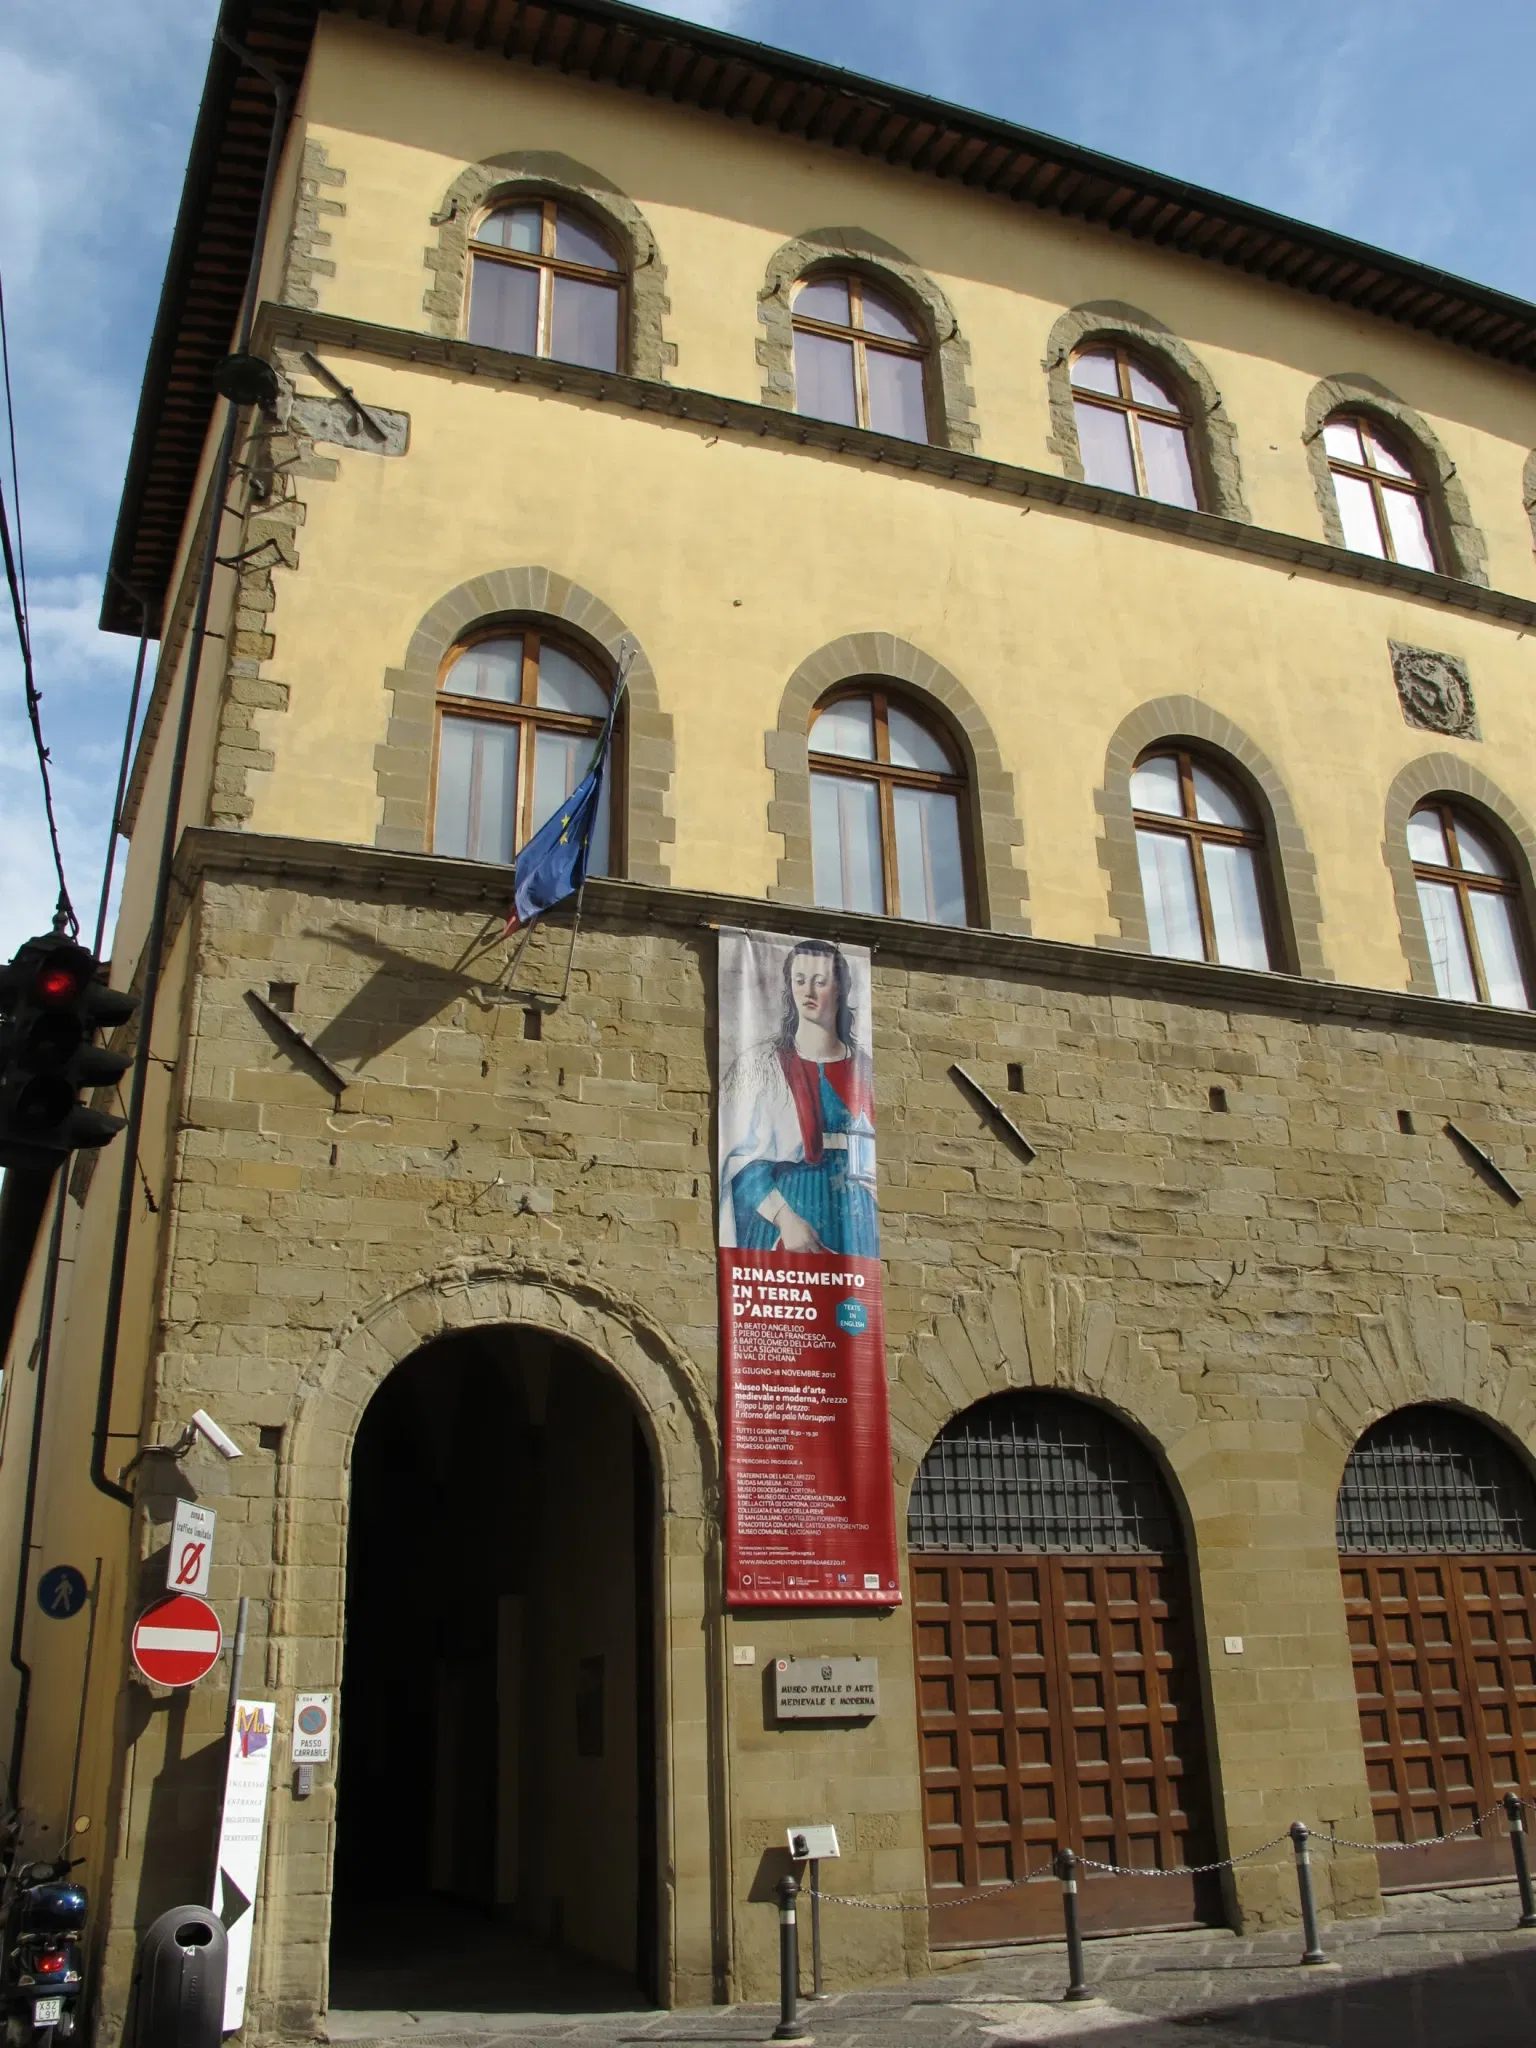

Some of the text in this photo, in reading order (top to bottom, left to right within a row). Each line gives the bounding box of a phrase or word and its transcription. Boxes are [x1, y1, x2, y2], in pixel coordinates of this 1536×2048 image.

[732, 1266, 864, 1288] RINASCIMENTO
[732, 1285, 812, 1302] IN TERRA
[733, 1300, 817, 1320] D'AREZZO
[768, 1324, 804, 1332] ANGELICO
[785, 1332, 826, 1341] FRANCESCA
[739, 1338, 788, 1347] BARTOLOMEO
[790, 1340, 812, 1348] DELLA
[759, 1346, 802, 1355] SIGNORELLI
[781, 1369, 820, 1377] NOVEMBRE
[735, 1383, 826, 1394] Museo Nazionale d'arte
[735, 1393, 774, 1401] medievale
[782, 1394, 819, 1404] moderna,
[736, 1401, 757, 1411] Filippo
[758, 1402, 775, 1412] Lippi
[786, 1403, 810, 1412] Arezzo:
[741, 1411, 763, 1419] ritorno
[764, 1411, 780, 1419] della
[782, 1412, 796, 1421] pala
[798, 1413, 835, 1422] Marsuppini
[177, 1522, 211, 1540] traffico limitato
[237, 1705, 271, 1735] Mus
[294, 1749, 327, 1757] CARRABILE
[229, 1780, 264, 1788] INGRESSO
[39, 2001, 57, 2010] X32
[38, 2010, 57, 2020] L9Y
